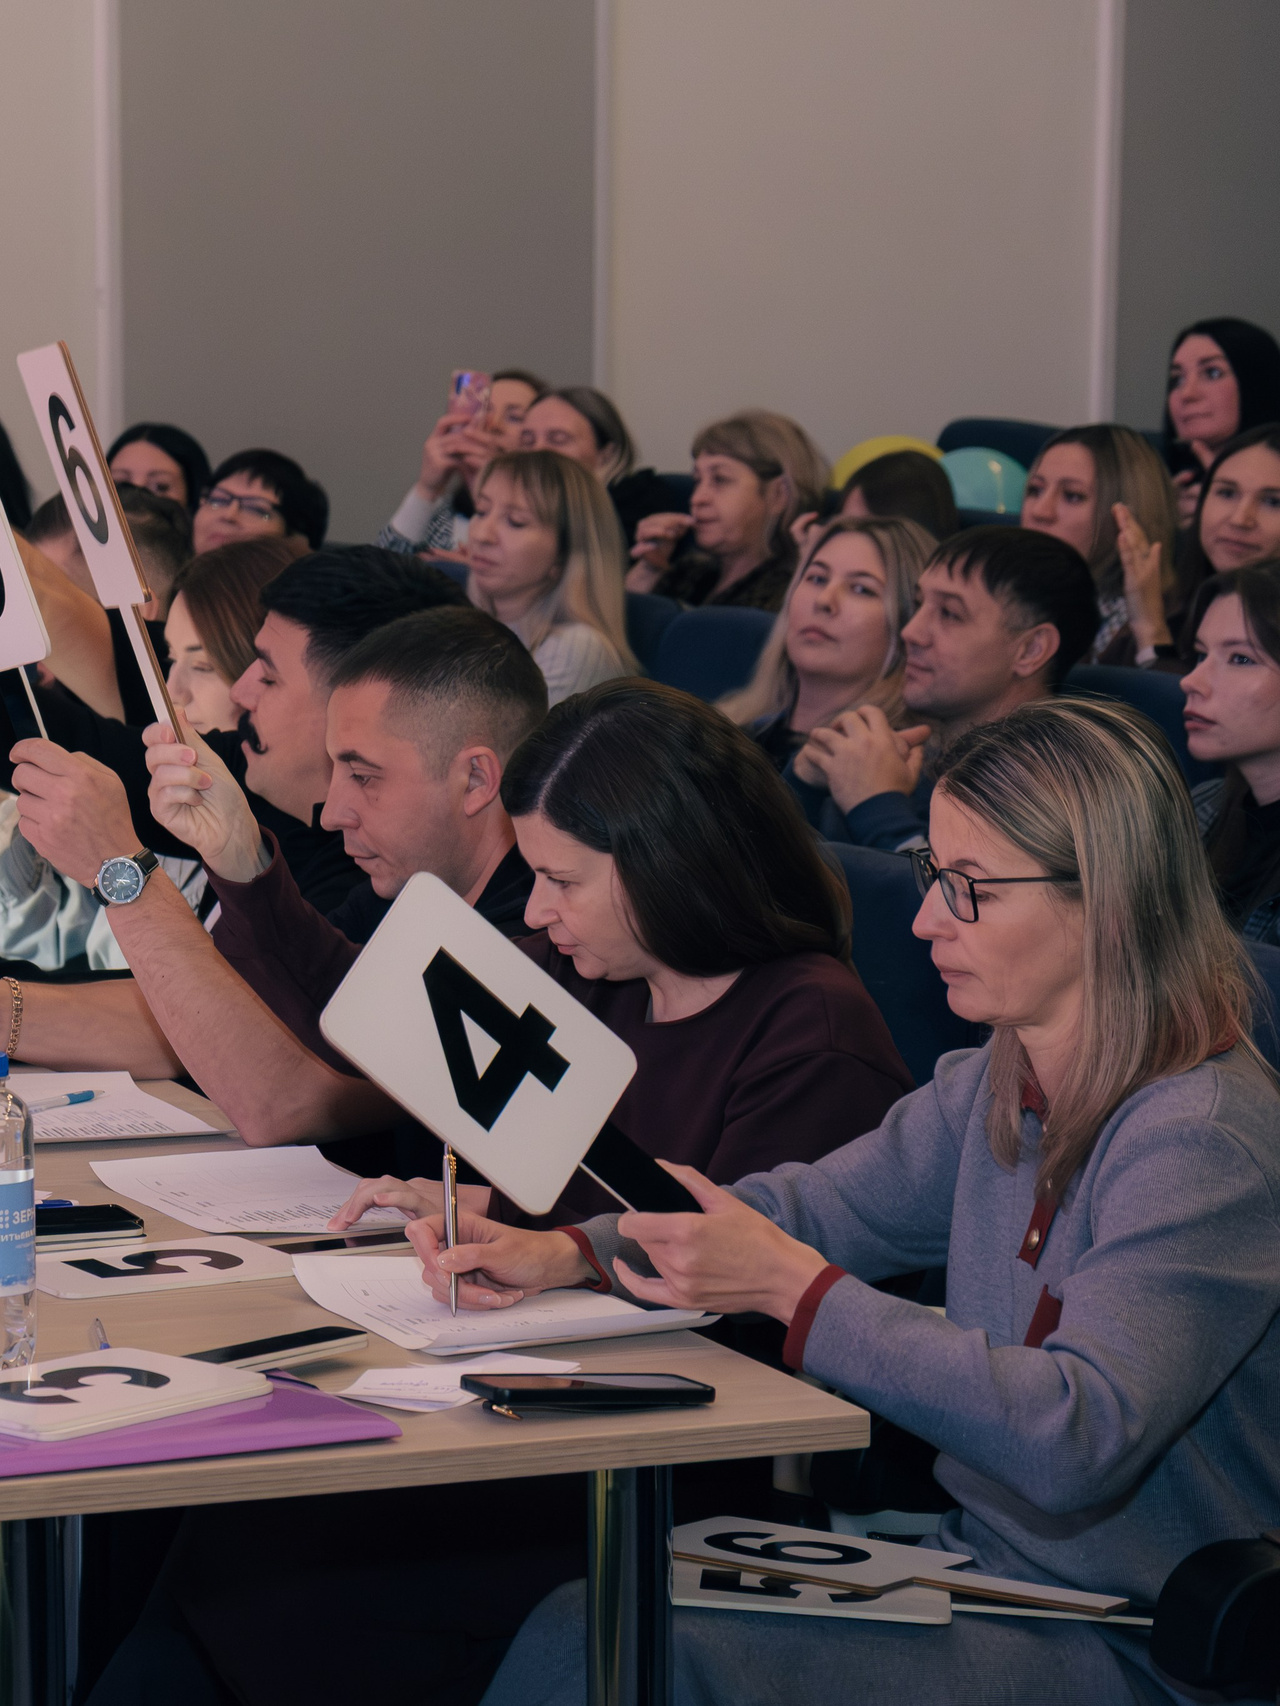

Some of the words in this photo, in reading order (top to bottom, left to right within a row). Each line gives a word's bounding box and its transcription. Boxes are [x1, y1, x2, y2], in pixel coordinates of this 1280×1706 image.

[48, 391, 110, 545] 6
[422, 946, 571, 1133] 4
[60, 1248, 245, 1279] 5
[703, 1531, 872, 1566] 6
